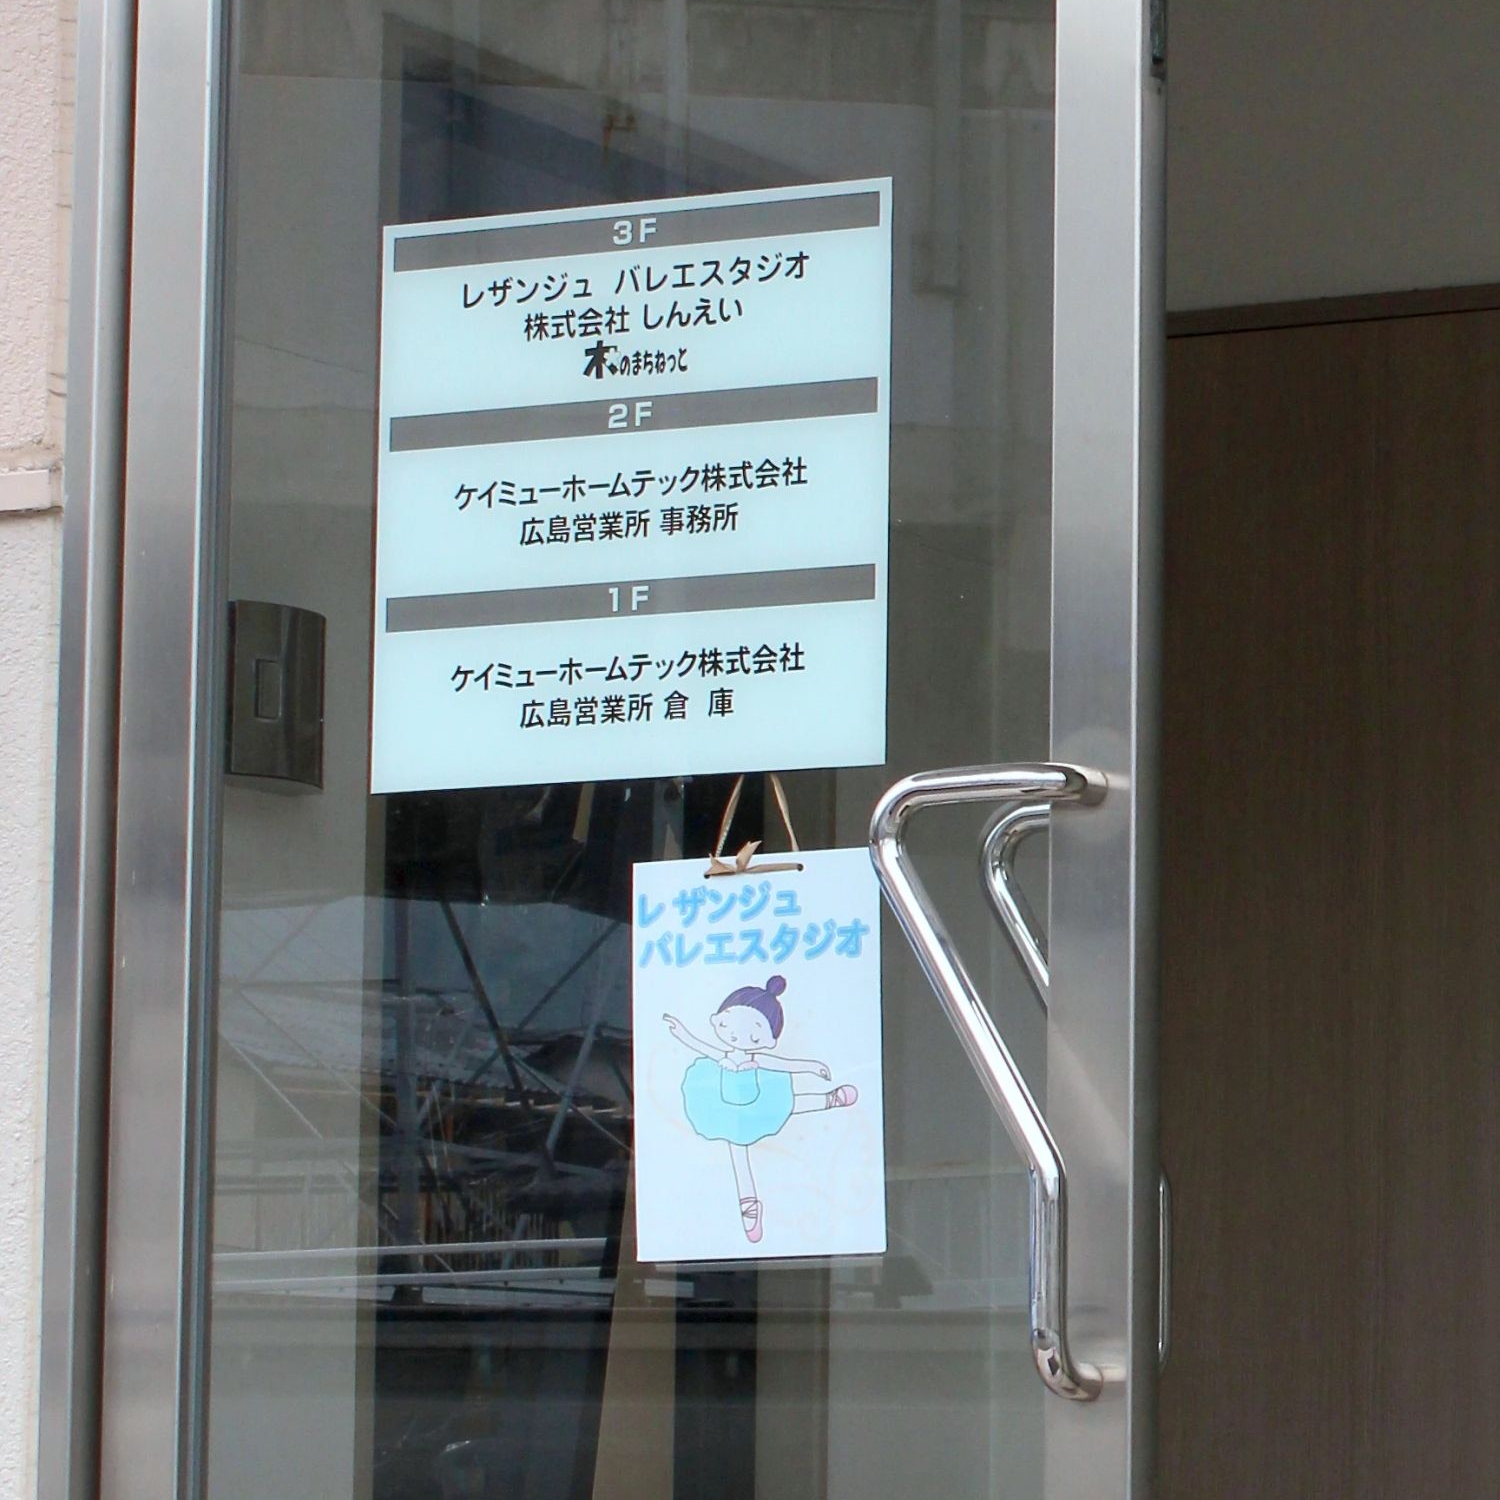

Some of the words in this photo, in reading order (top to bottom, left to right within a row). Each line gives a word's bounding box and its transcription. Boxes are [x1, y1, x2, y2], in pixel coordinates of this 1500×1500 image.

[611, 217, 658, 247] 3F
[463, 272, 593, 311] レザンジュ
[613, 250, 811, 296] バレエスタジオ
[523, 306, 630, 342] 株式会社
[643, 298, 743, 331] しんえい
[607, 401, 654, 430] 2F
[454, 456, 808, 511] ケイミューホームテック株式会社
[519, 509, 650, 546] 広島営業所
[659, 502, 739, 536] 事務所
[608, 585, 650, 613] 1F
[450, 642, 805, 693] ケイミューホームテック株式会社
[519, 693, 653, 730] 広島営業所
[639, 918, 869, 968] バレエスタジオ
